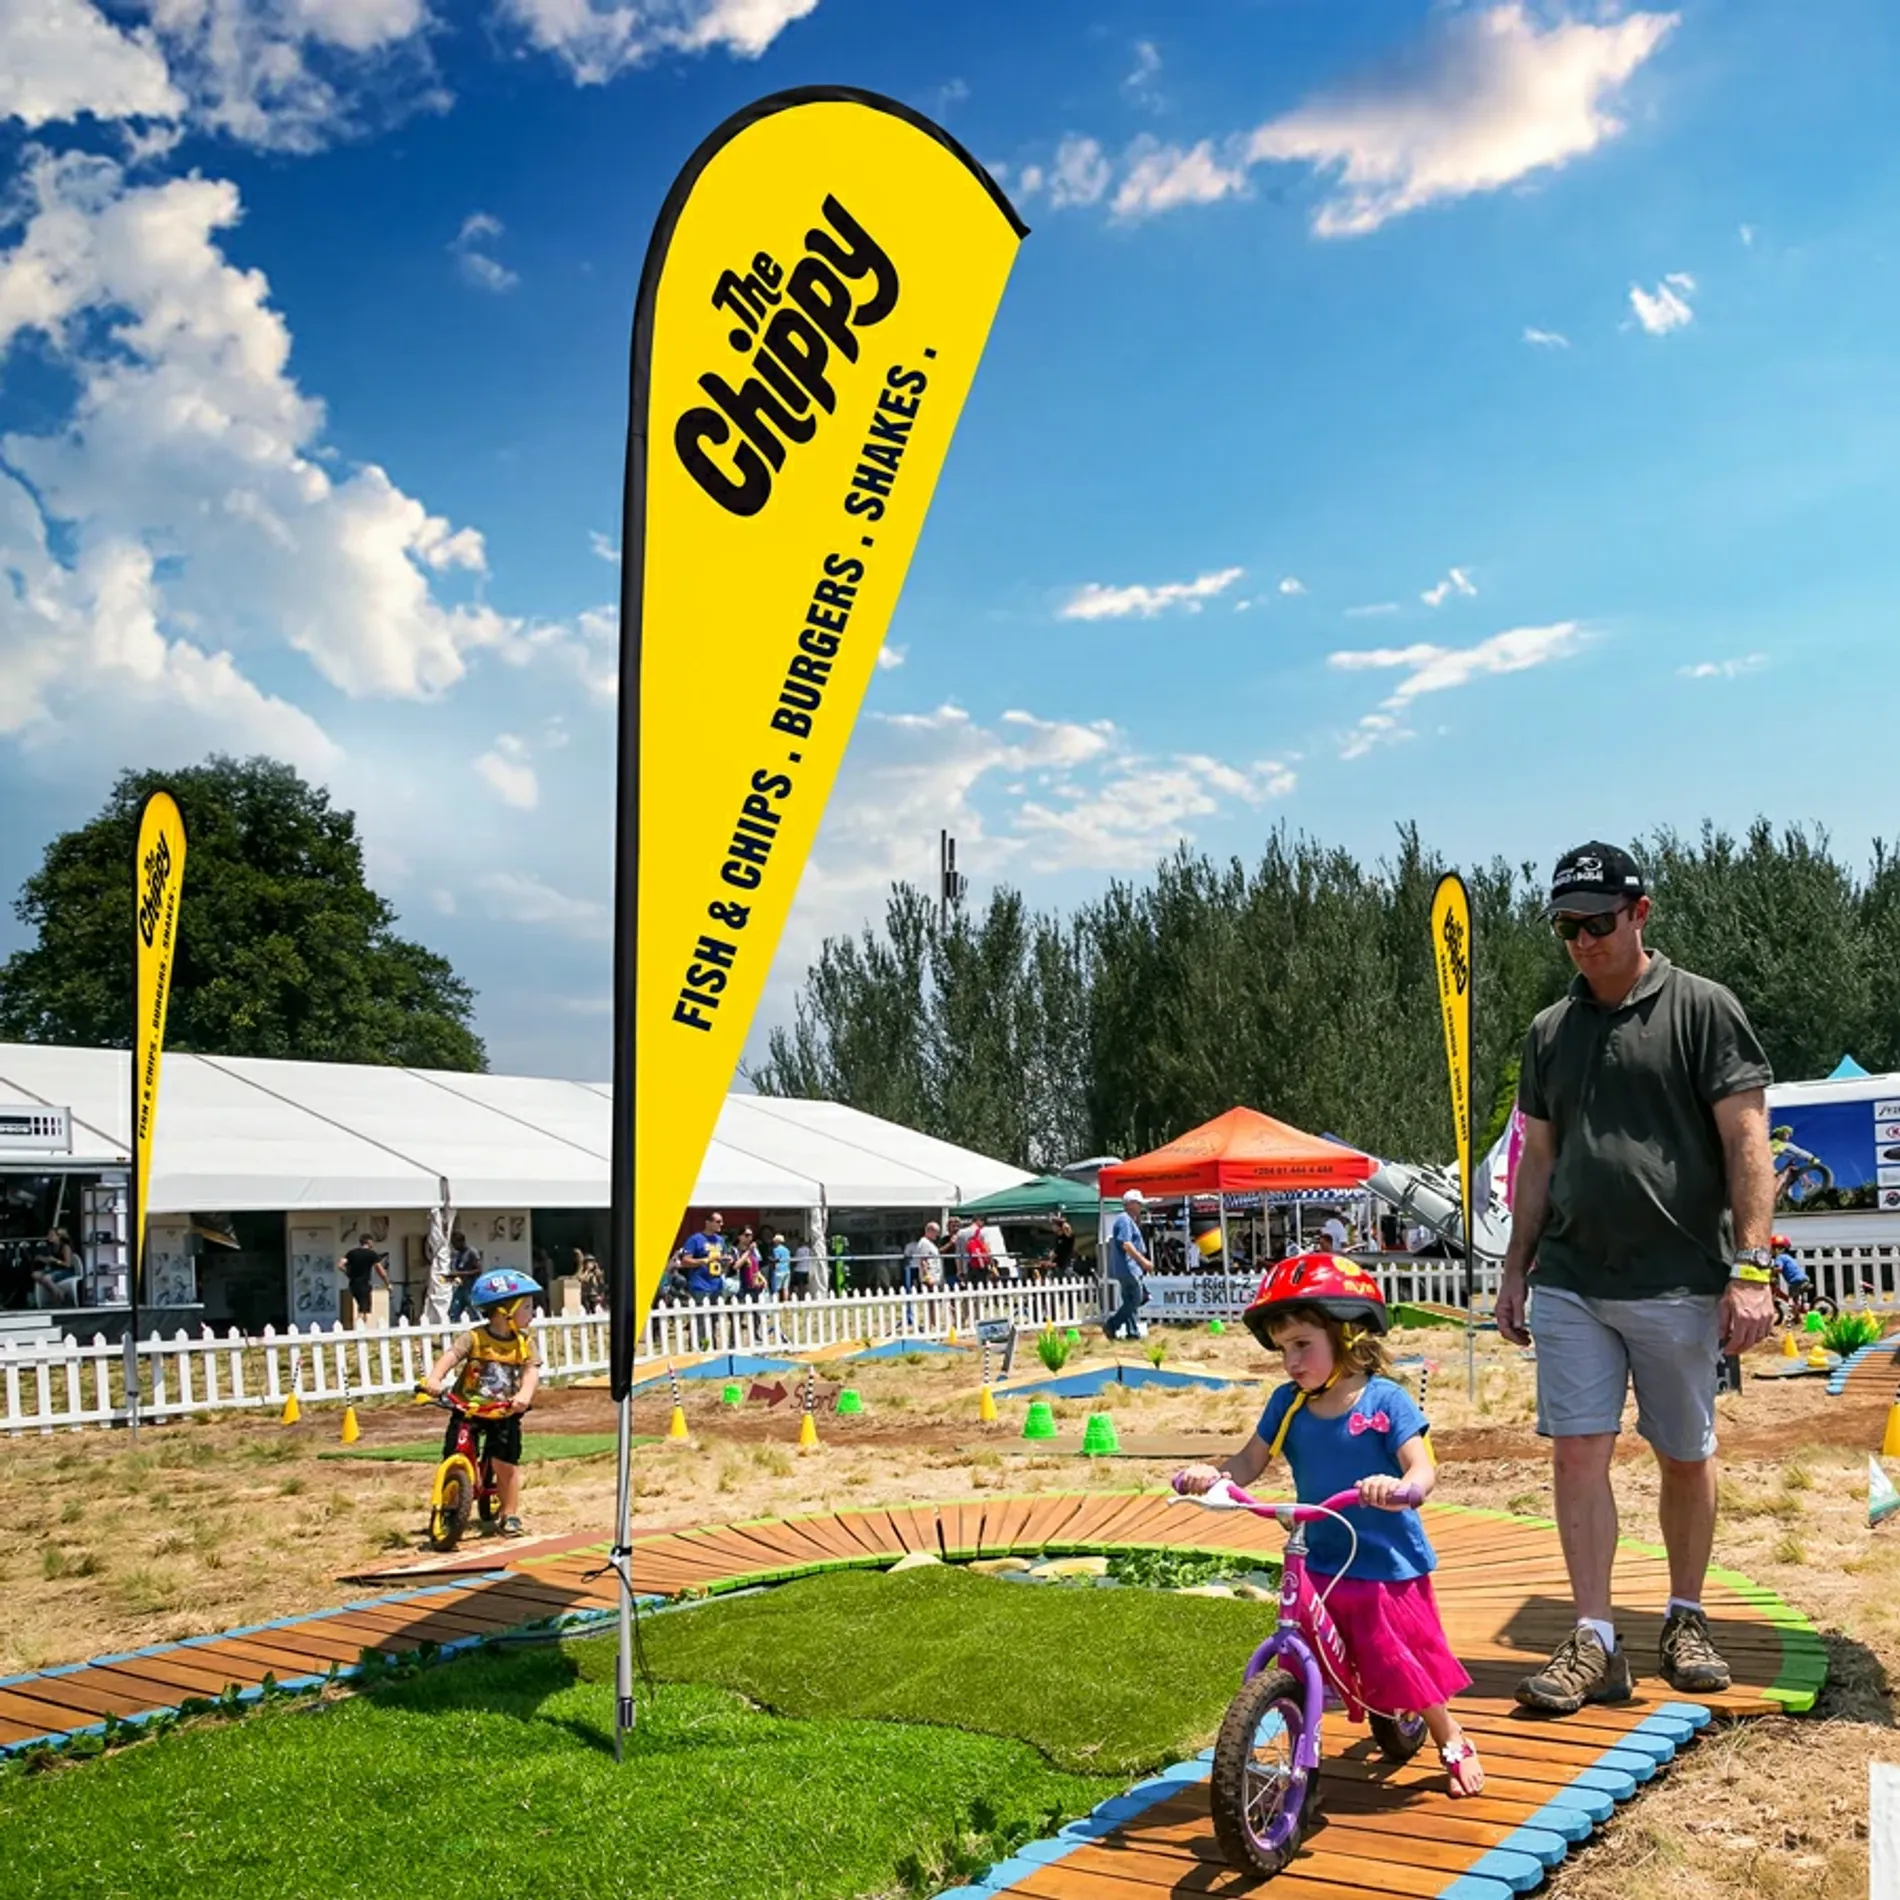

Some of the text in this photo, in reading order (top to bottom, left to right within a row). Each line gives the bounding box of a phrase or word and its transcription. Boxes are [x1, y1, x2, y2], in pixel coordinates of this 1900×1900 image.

[711, 251, 784, 335] The
[674, 193, 899, 517] Chippy
[845, 365, 927, 522] SHAKES
[771, 553, 865, 739] BURGERS
[720, 769, 793, 890] CHIPS
[140, 829, 171, 949] Chippy
[708, 901, 751, 930] &
[672, 936, 738, 1032] FISH
[145, 1041, 158, 1086] CHIPS
[1163, 1290, 1197, 1304] MTB
